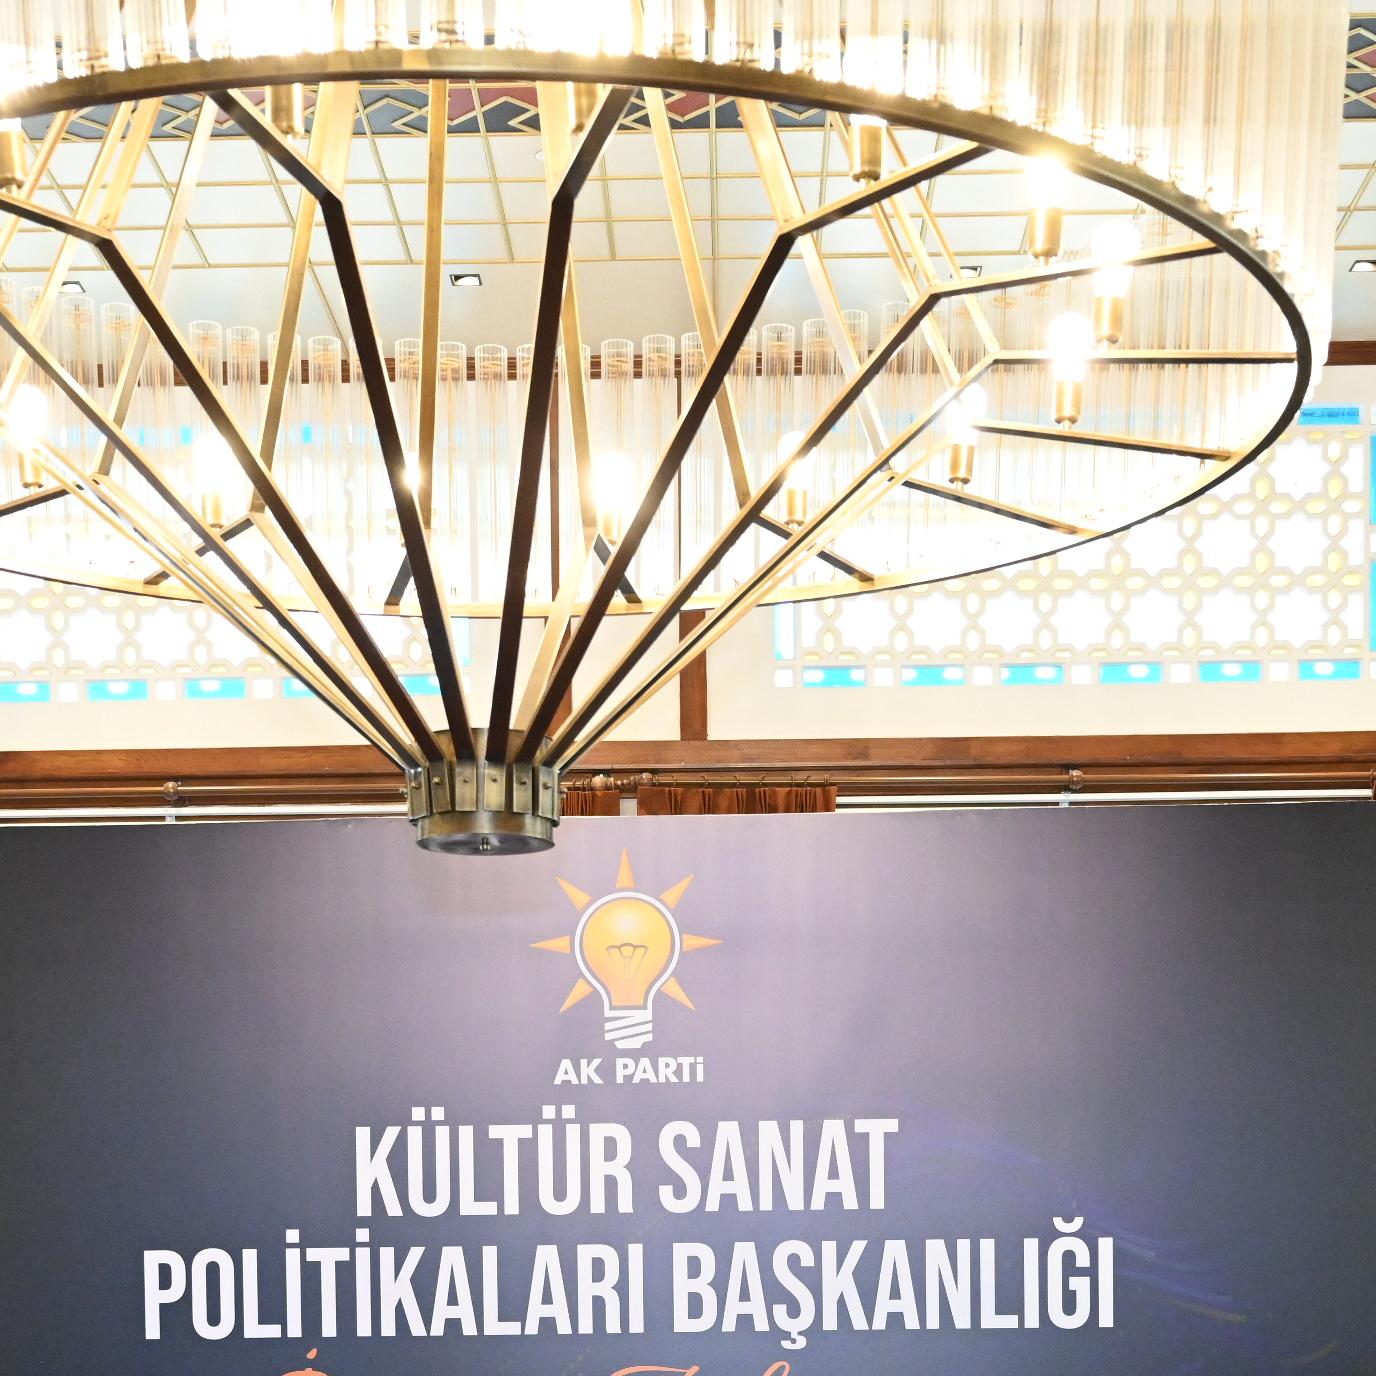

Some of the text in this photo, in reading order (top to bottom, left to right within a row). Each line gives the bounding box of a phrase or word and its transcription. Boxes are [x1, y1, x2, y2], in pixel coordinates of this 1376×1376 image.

[553, 1057, 604, 1085] AK
[355, 1104, 899, 1218] KÜLTÜR SANAT
[143, 1216, 1114, 1350] POLİTİKALARI BAŞKANLIĞI
